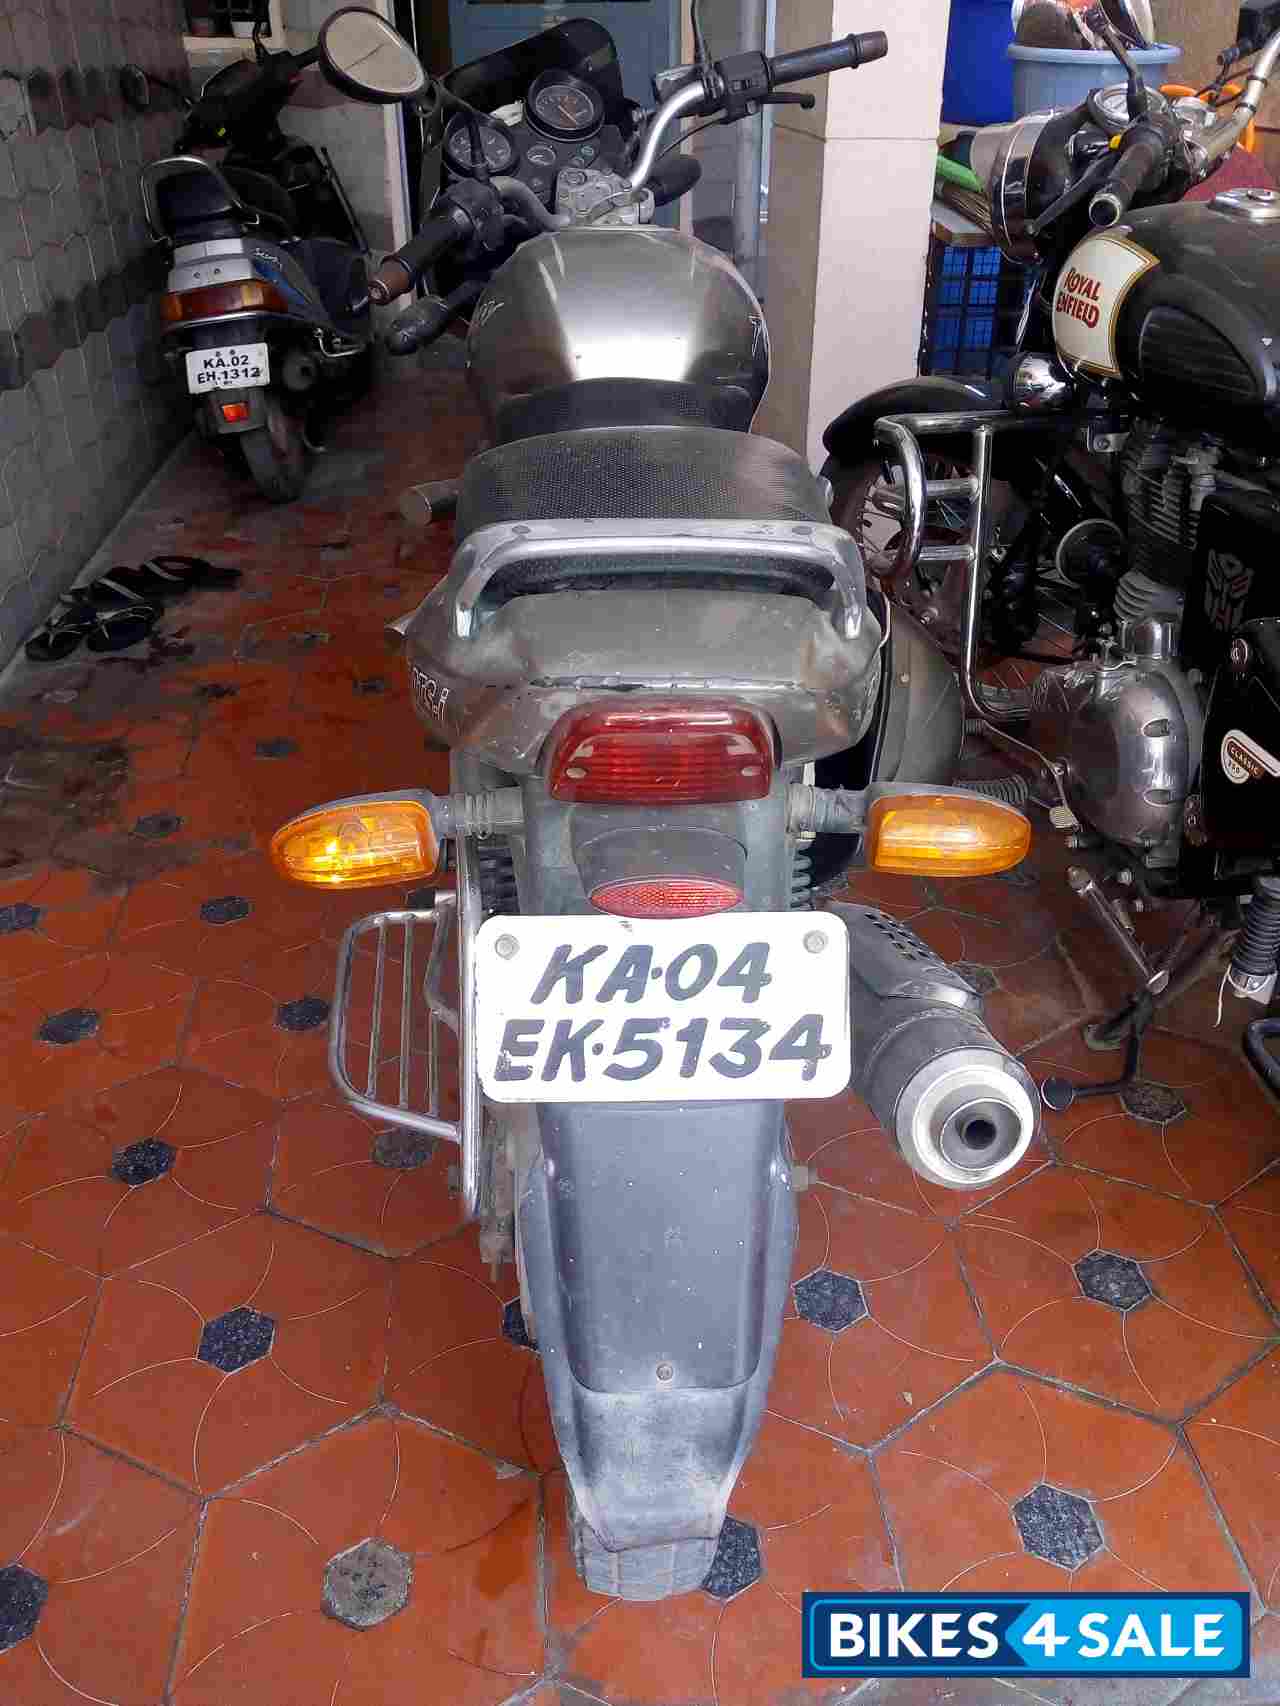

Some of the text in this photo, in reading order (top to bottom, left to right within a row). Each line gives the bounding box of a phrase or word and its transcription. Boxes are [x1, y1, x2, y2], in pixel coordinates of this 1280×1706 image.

[1064, 267, 1101, 301] ROYAL
[1056, 291, 1100, 329] ENFIELD
[203, 354, 249, 369] KA.02
